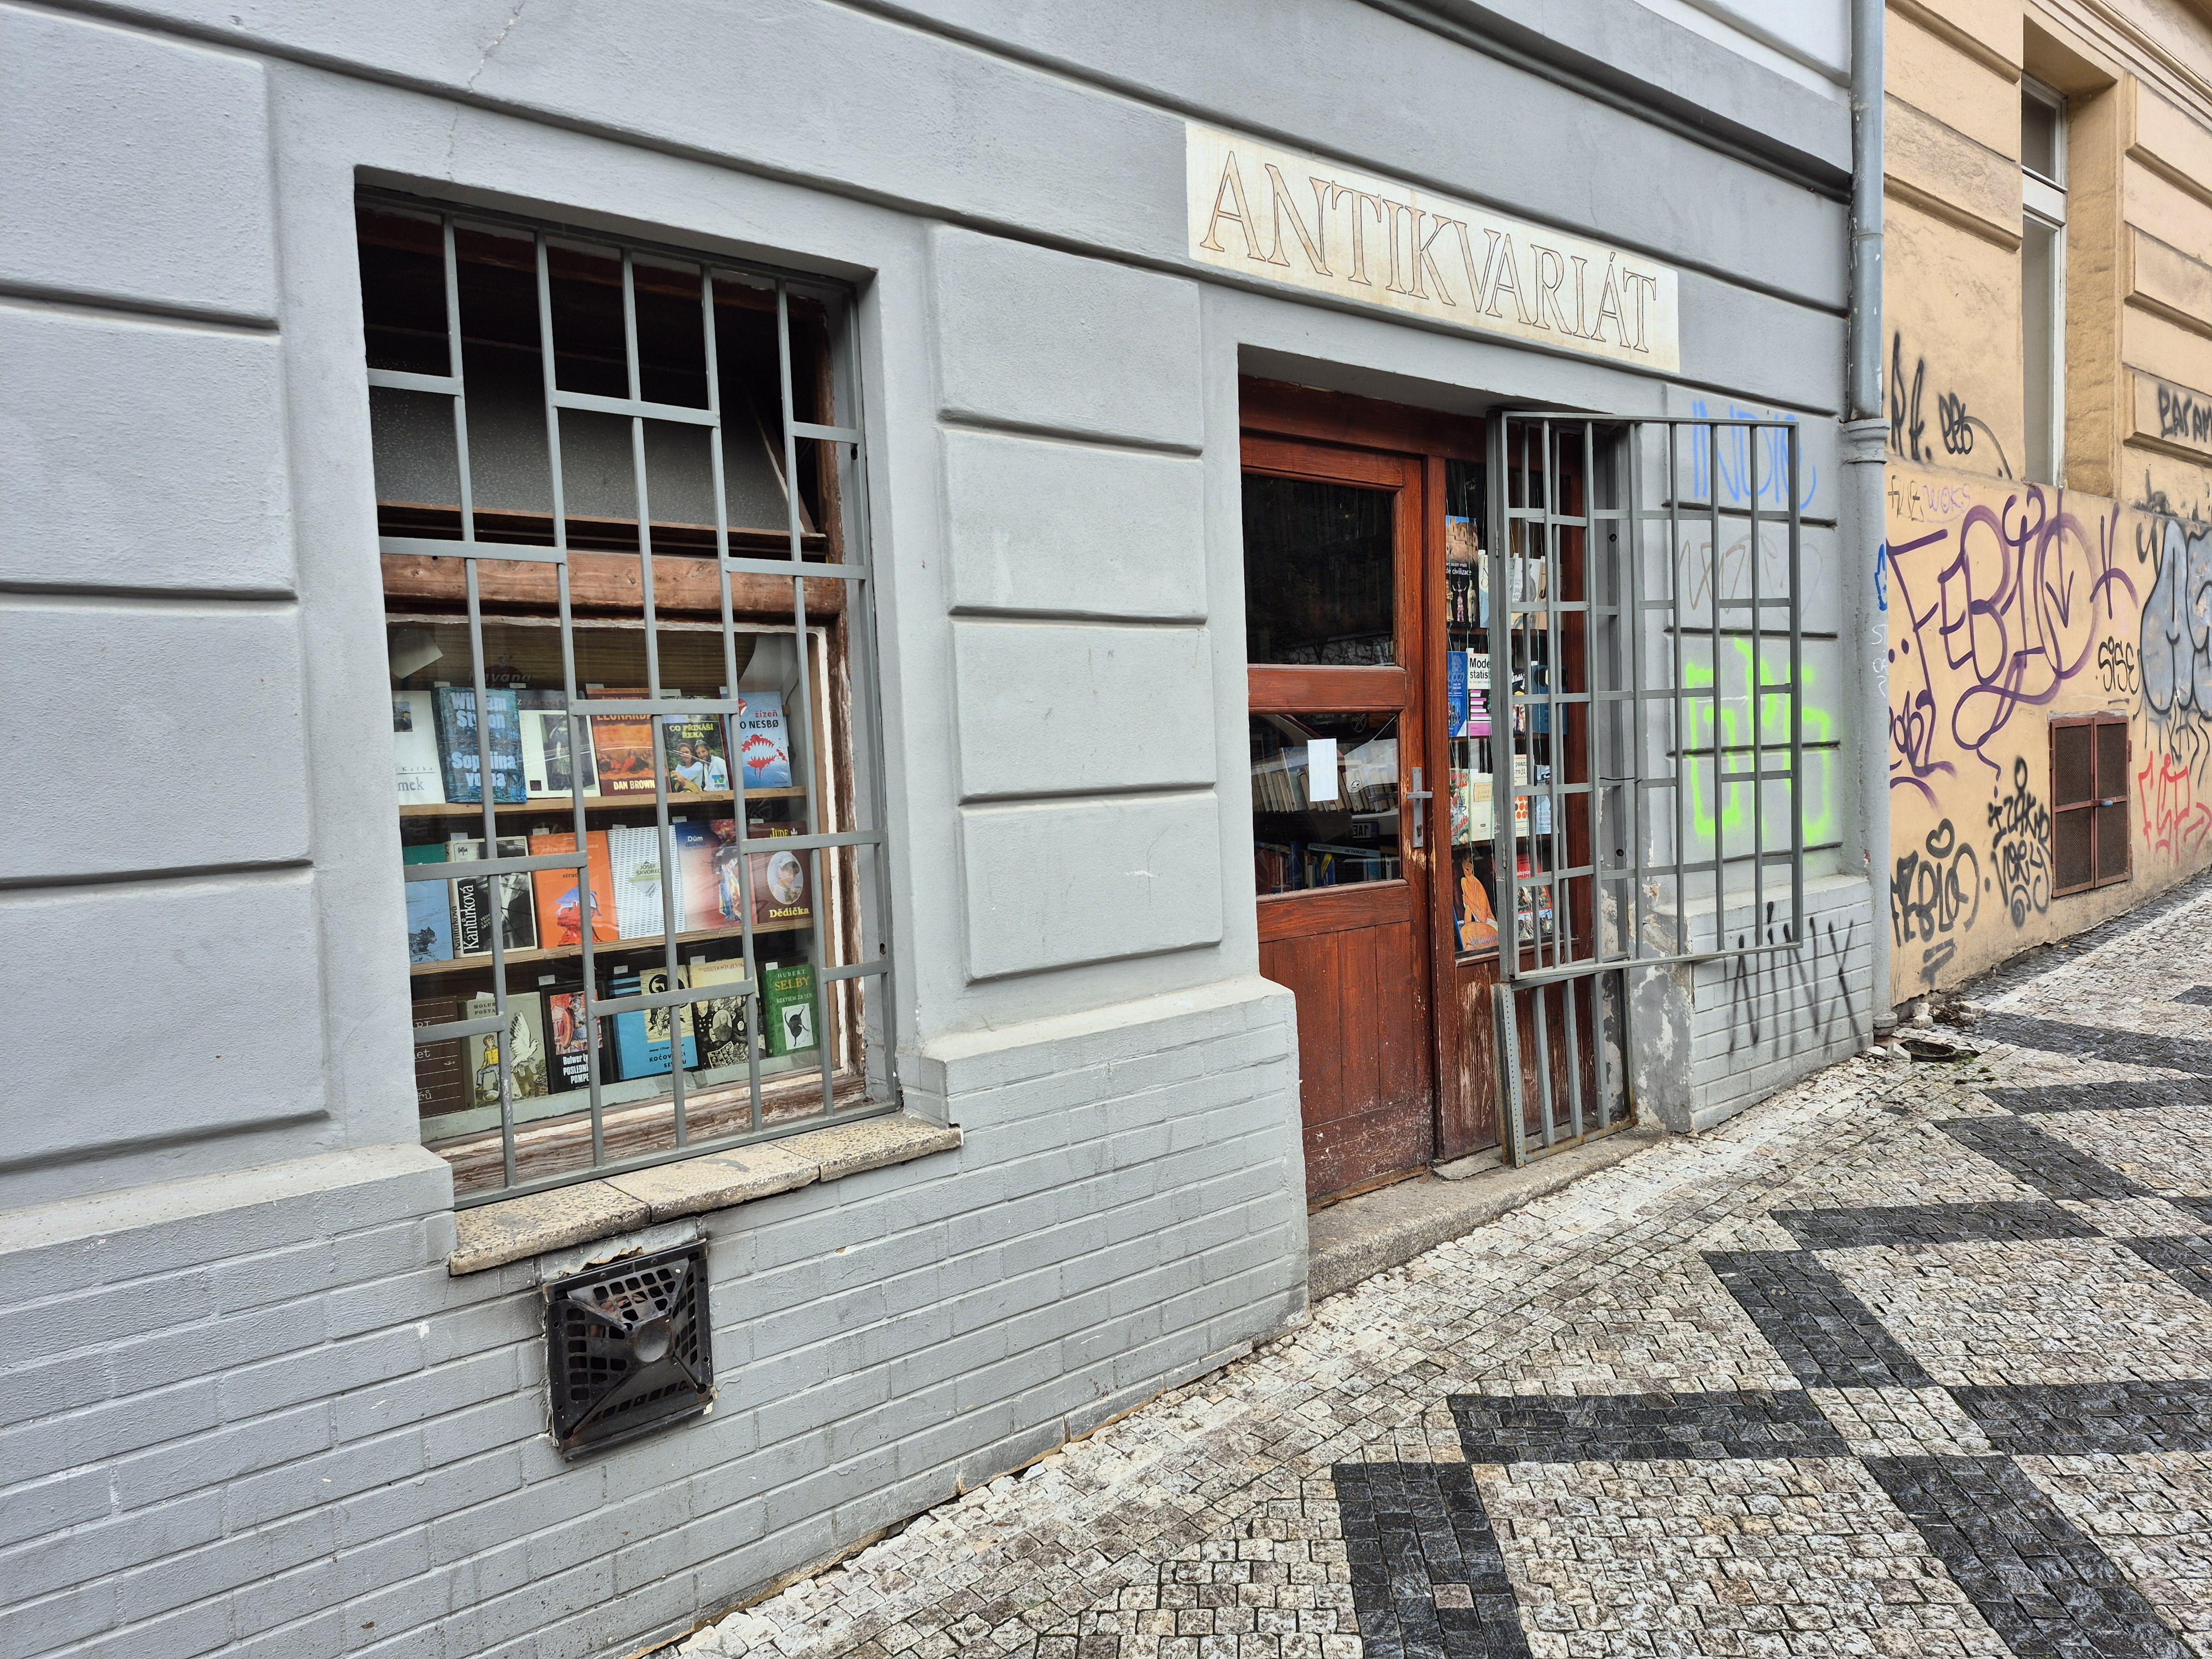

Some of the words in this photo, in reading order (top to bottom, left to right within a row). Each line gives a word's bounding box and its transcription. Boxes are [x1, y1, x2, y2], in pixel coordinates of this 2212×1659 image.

[1199, 150, 1657, 353] ANTIKVARIÁT
[1469, 670, 1491, 679] statis
[683, 723, 714, 732] PŘINÁŠÍ
[749, 719, 779, 729] NESBØ
[451, 751, 517, 772] Sopiina
[613, 780, 628, 791] DAN
[630, 779, 655, 790] BROWN
[460, 885, 479, 950] Kantůrková
[769, 906, 810, 919] Dědička
[778, 969, 806, 978] HUBERT
[774, 976, 810, 991] SELBY
[563, 1055, 582, 1066] Bulwer
